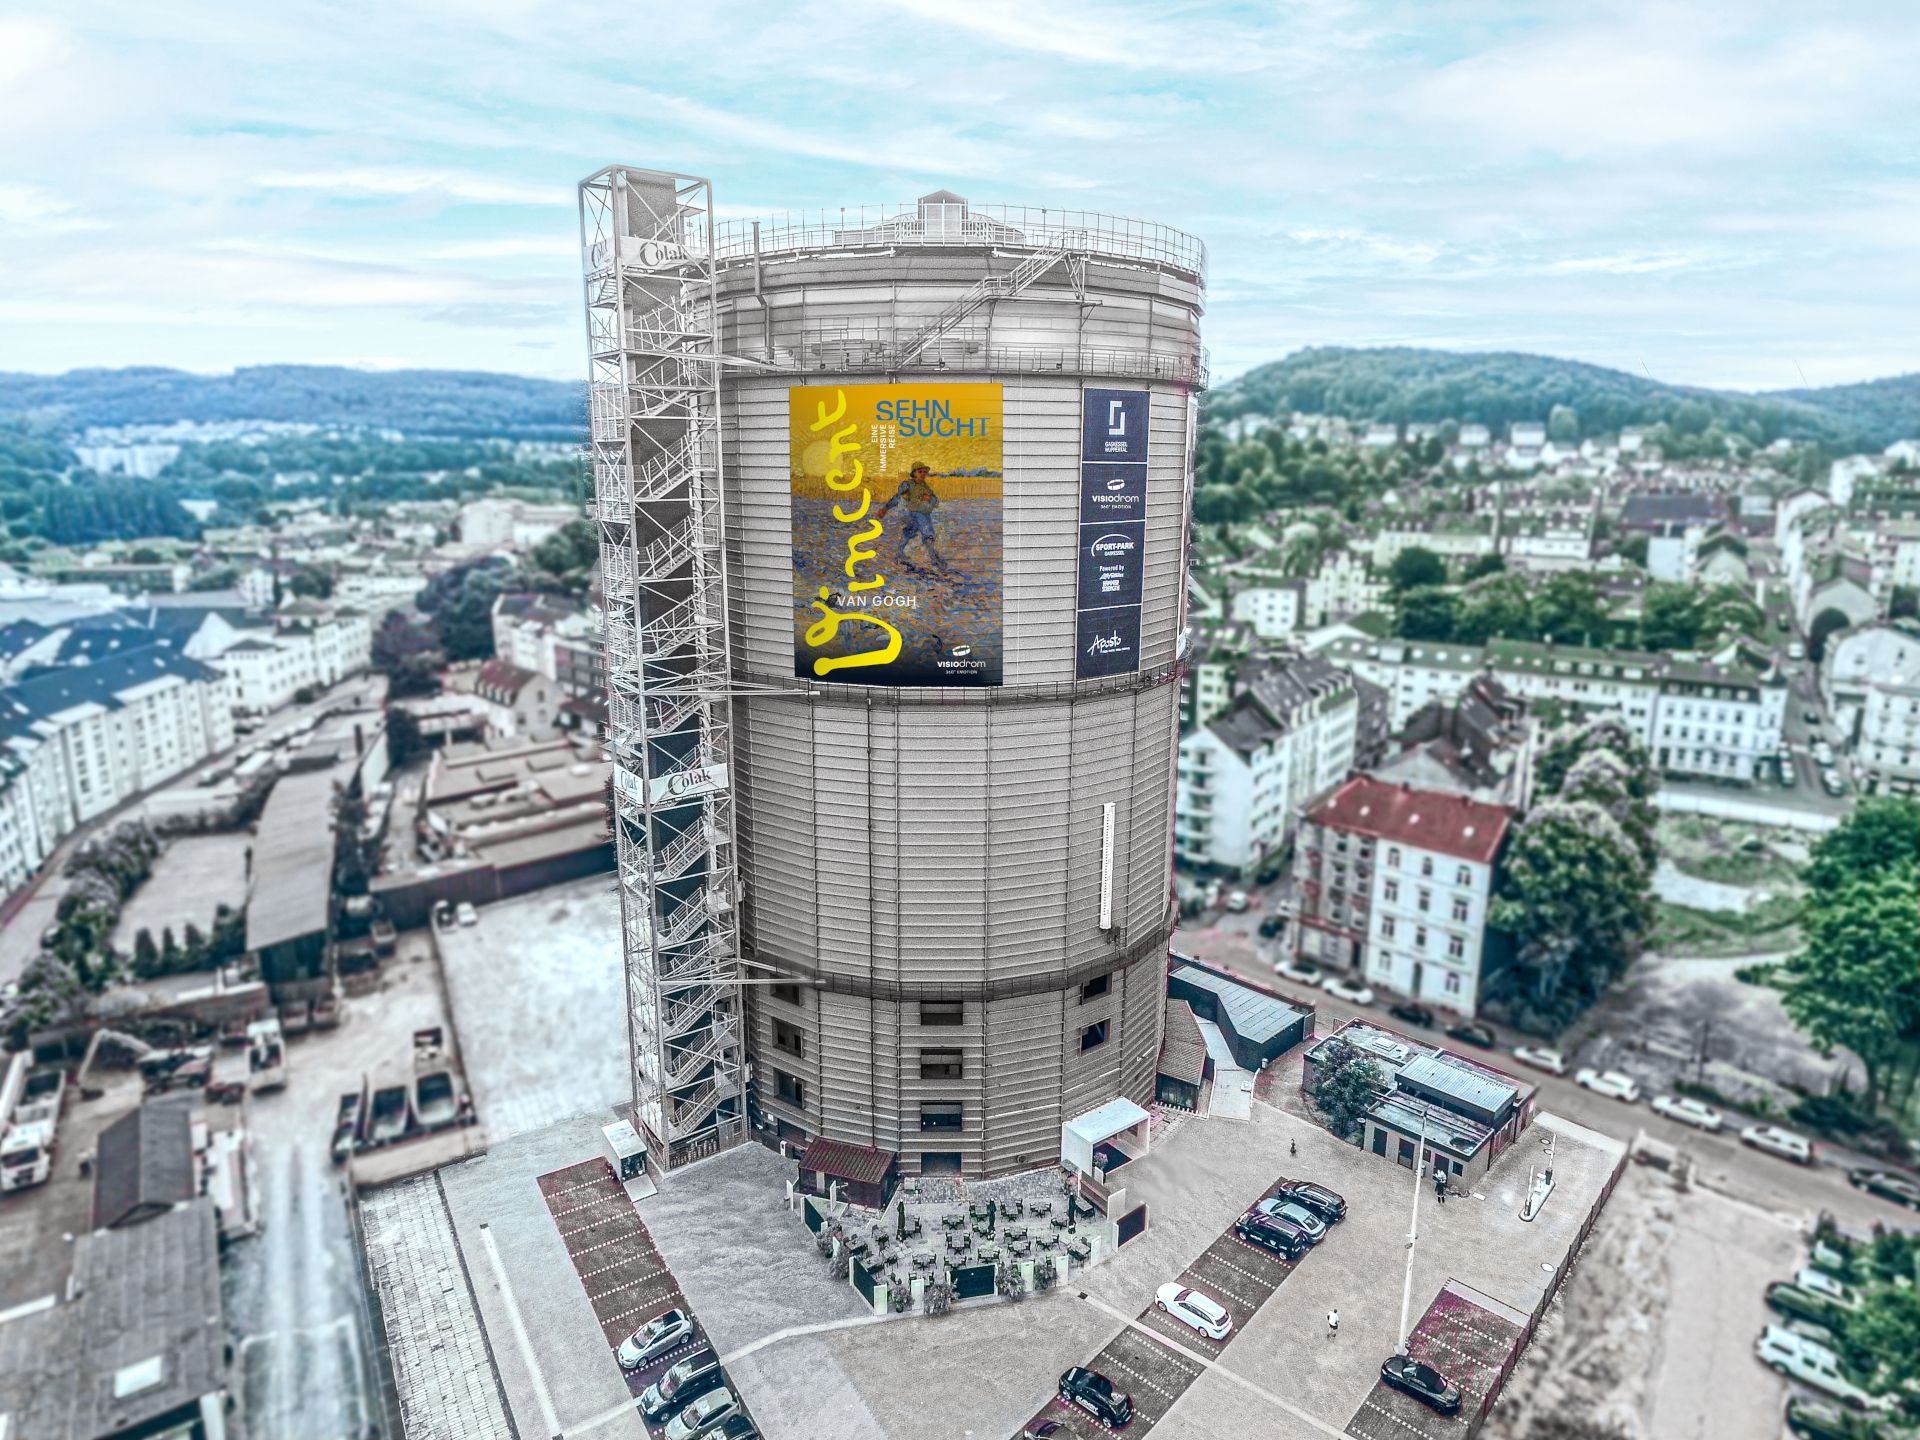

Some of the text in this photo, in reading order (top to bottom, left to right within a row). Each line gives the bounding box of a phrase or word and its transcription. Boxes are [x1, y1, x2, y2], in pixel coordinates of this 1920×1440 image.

[876, 399, 950, 421] SEHN
[899, 417, 991, 437] SUCHT
[805, 389, 903, 676] Vincent
[1095, 542, 1134, 551] SPORT-PARK
[837, 595, 916, 607] VAN GOGH
[667, 768, 712, 796] Colak
